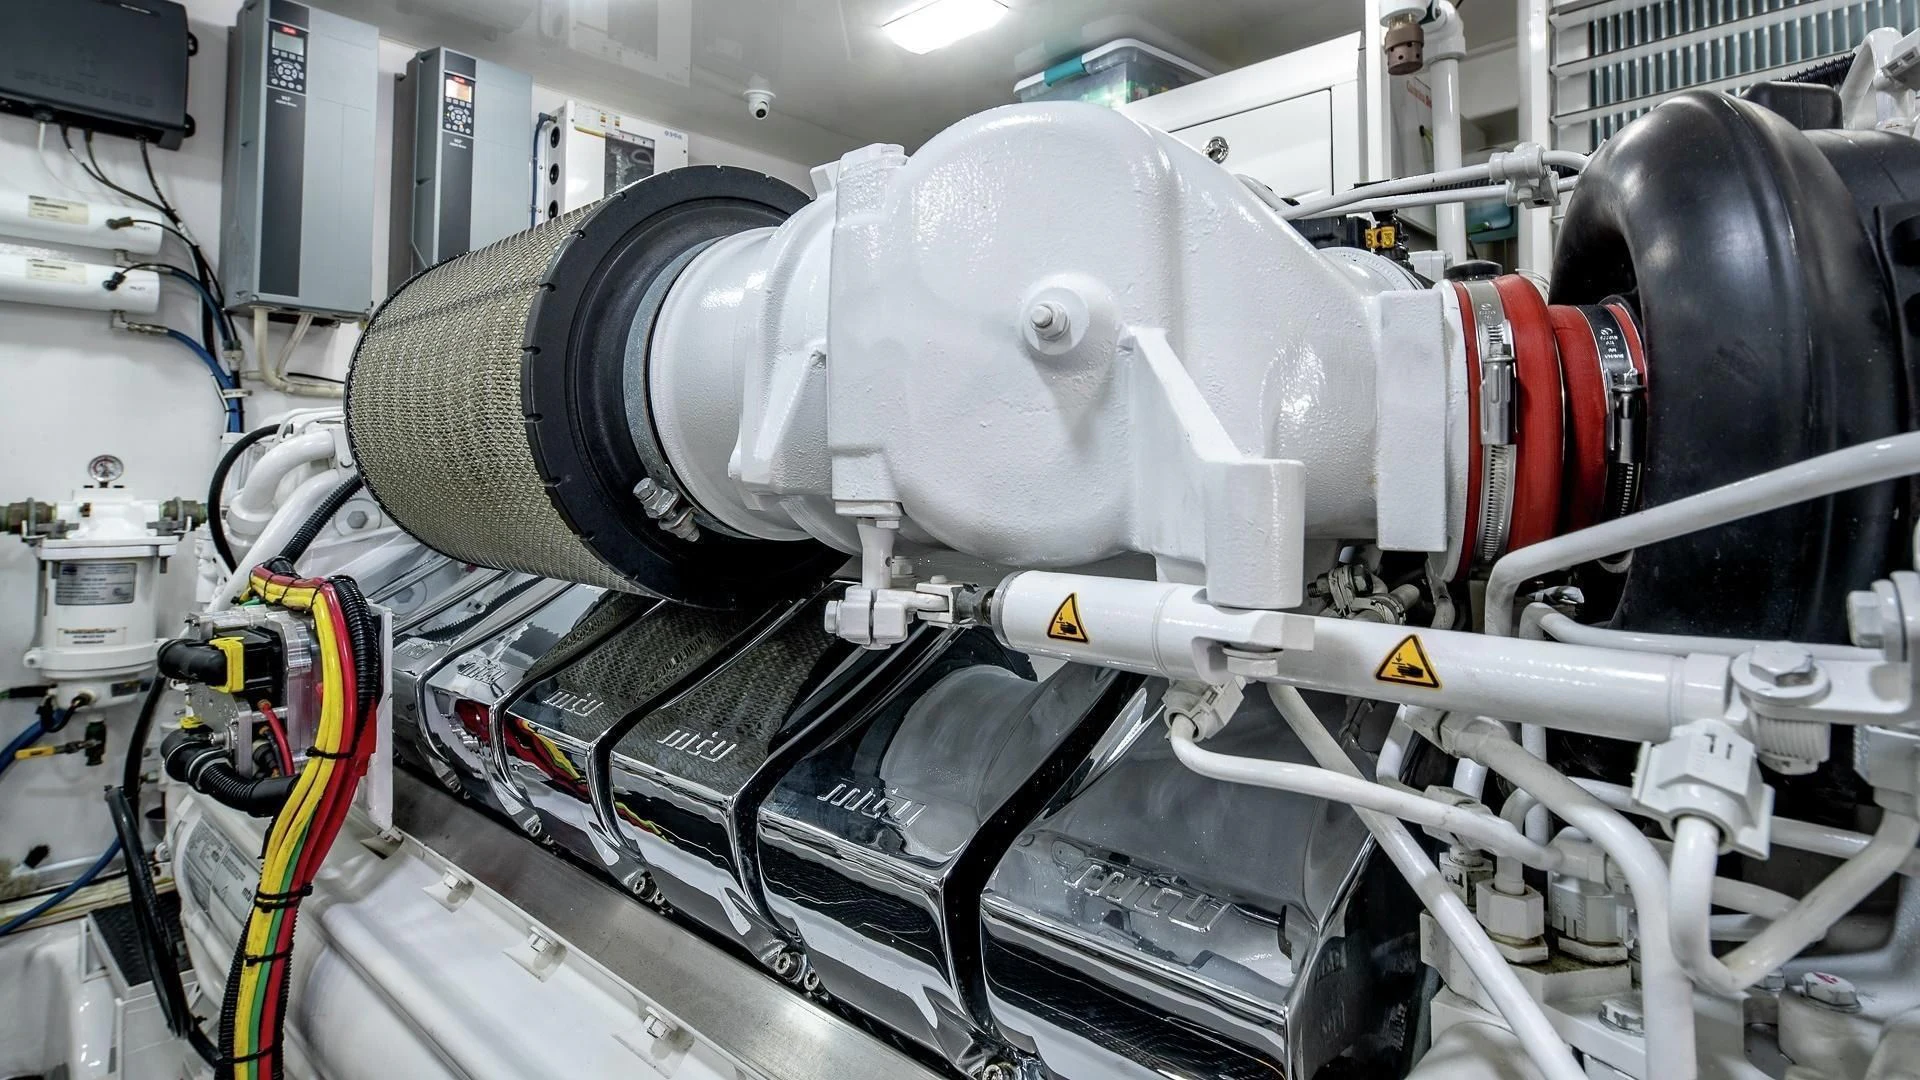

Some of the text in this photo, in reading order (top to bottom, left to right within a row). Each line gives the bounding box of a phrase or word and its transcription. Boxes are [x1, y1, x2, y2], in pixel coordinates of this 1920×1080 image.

[541, 690, 604, 717] mtu
[657, 730, 737, 762] mtu
[816, 783, 927, 828] mtu
[1063, 864, 1233, 934] mtu
